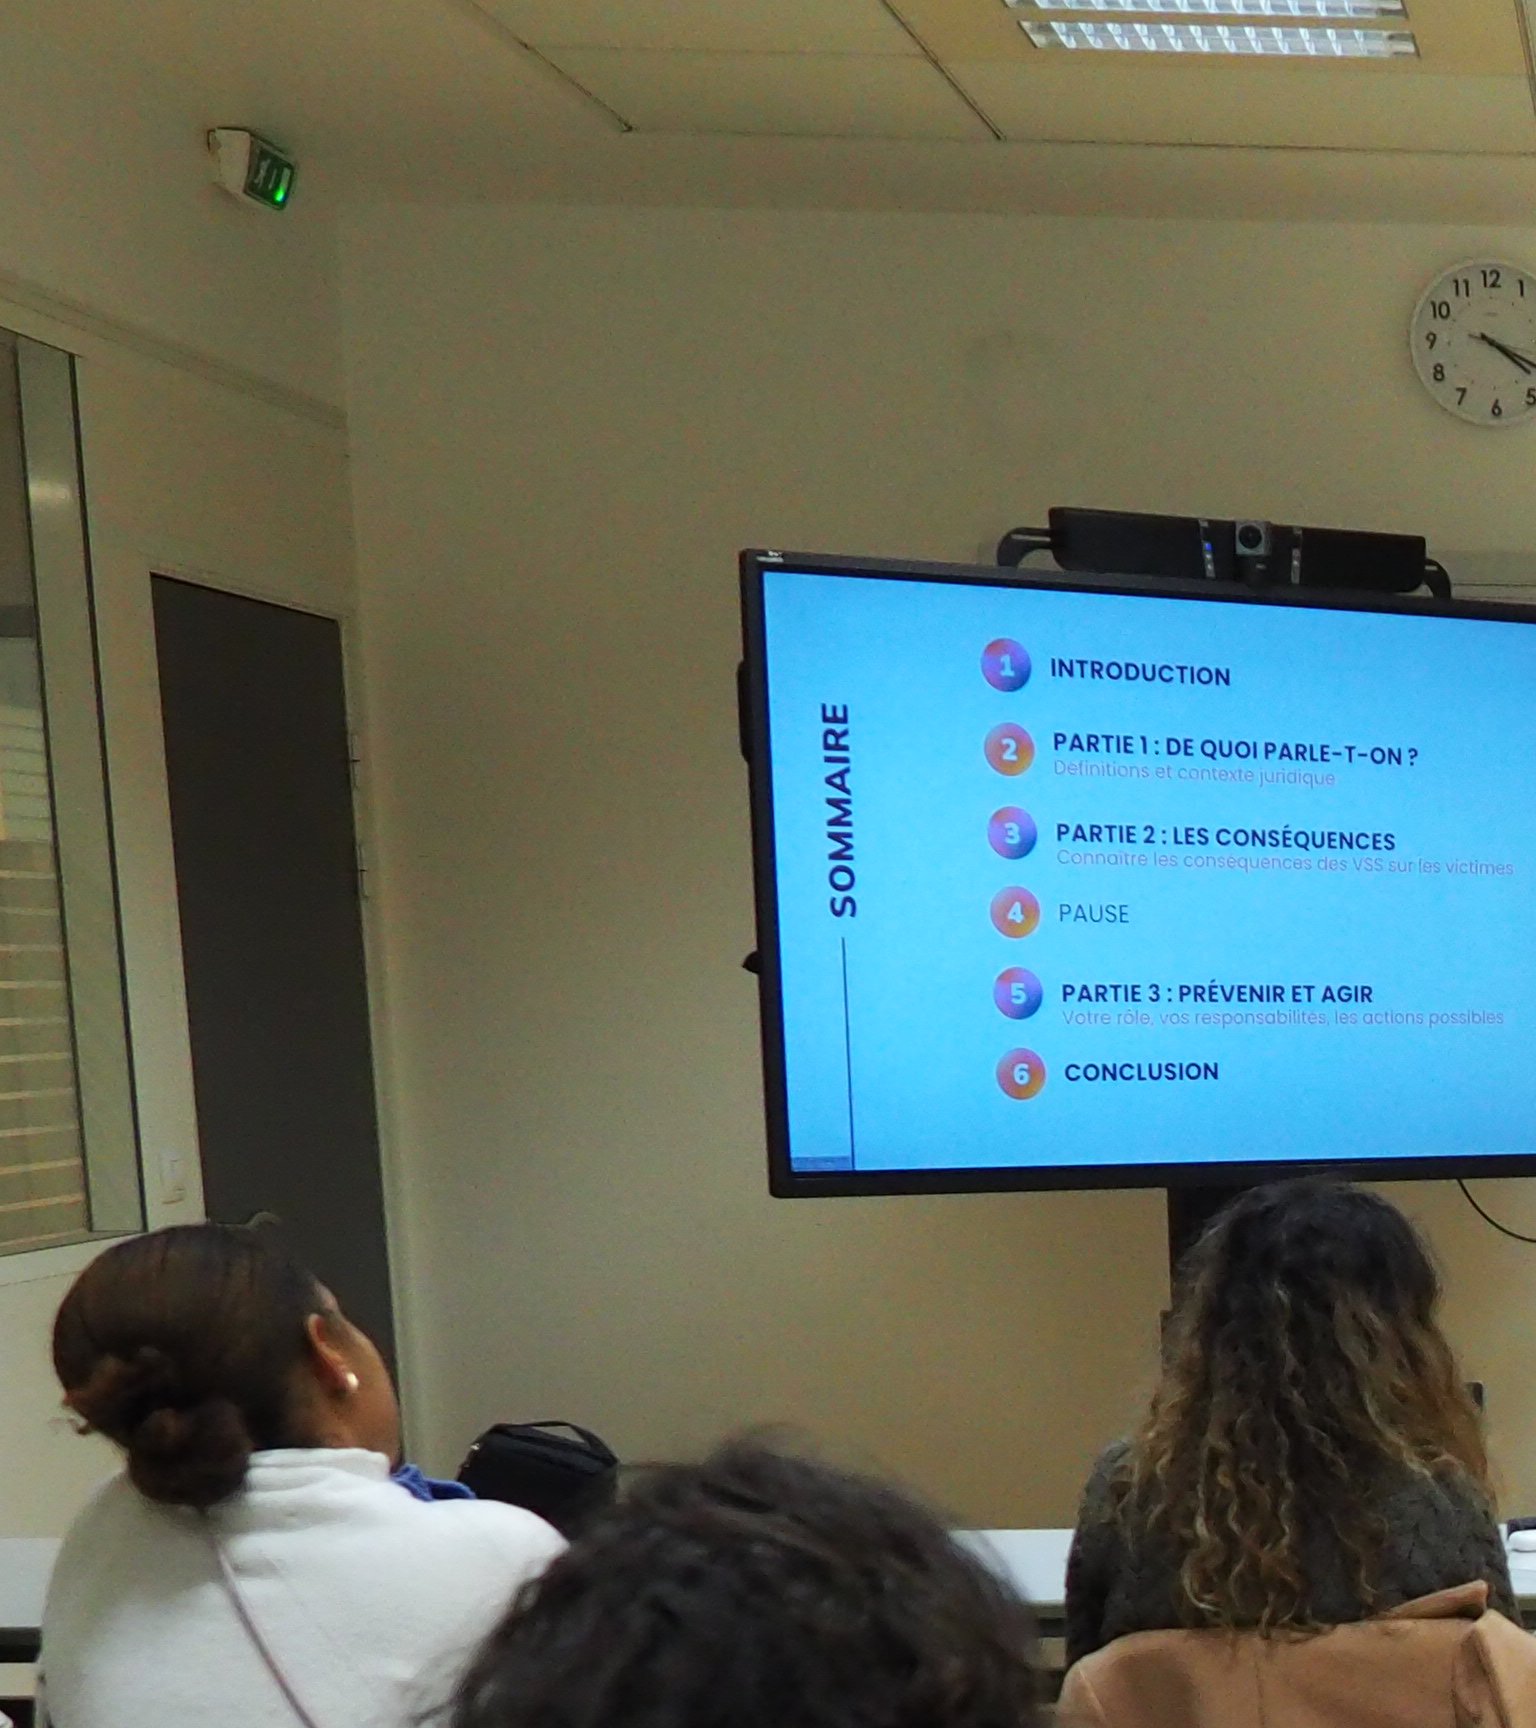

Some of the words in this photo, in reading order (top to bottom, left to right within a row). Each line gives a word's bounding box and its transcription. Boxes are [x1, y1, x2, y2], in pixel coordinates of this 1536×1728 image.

[1452, 279, 1470, 297] 11
[1480, 269, 1502, 289] 12
[1517, 279, 1525, 297] 1
[1430, 300, 1451, 320] 10
[1425, 332, 1437, 350] 9
[1432, 362, 1446, 382] 8
[1455, 387, 1467, 406] 7
[1491, 398, 1503, 417] 6
[999, 654, 1015, 678] 1
[1050, 657, 1231, 687] INTRODUCTION
[1000, 737, 1019, 761] 2
[1053, 732, 1135, 755] PARTIE
[1140, 735, 1148, 755] 1
[1166, 737, 1195, 757] DE
[1200, 738, 1258, 761] QUOI
[1263, 741, 1403, 767] PARLE-T-ON
[1406, 748, 1419, 767] ?
[1054, 759, 1150, 780] Définitions
[1156, 764, 1173, 780] et
[1178, 767, 1255, 782] contexte
[1259, 767, 1336, 789] juridique
[821, 702, 857, 919] SOMMAIRE
[1003, 823, 1021, 845] 3
[1056, 823, 1137, 844] PARTIE
[1143, 824, 1156, 845] 2
[1173, 826, 1209, 846] LES
[1215, 824, 1396, 852] CONSÉQUENCES
[1056, 848, 1148, 866] Connaître
[1153, 850, 1178, 867] les
[1183, 852, 1313, 874] conséquences
[1317, 855, 1348, 872] des
[1352, 857, 1384, 873] VSS
[1388, 860, 1414, 873] sur
[1418, 858, 1441, 874] les
[1446, 858, 1514, 876] victimes
[1008, 901, 1025, 924] 4
[1058, 903, 1130, 924] PAUSE
[1009, 982, 1027, 1004] 5
[1061, 984, 1142, 1003] PARTIE
[1148, 984, 1161, 1003] 3
[1178, 978, 1285, 1003] PRÉVENIR
[1291, 985, 1316, 1003] ET
[1321, 985, 1373, 1003] AGIR
[1062, 1009, 1111, 1025] Votre
[1117, 1008, 1154, 1027] rôle,
[1159, 1011, 1190, 1025] vos
[1335, 1010, 1357, 1025] les
[1362, 1009, 1424, 1025] actions
[1428, 1009, 1504, 1029] possibles
[1012, 1063, 1030, 1085] 6
[1064, 1062, 1219, 1082] CONCLUSION
